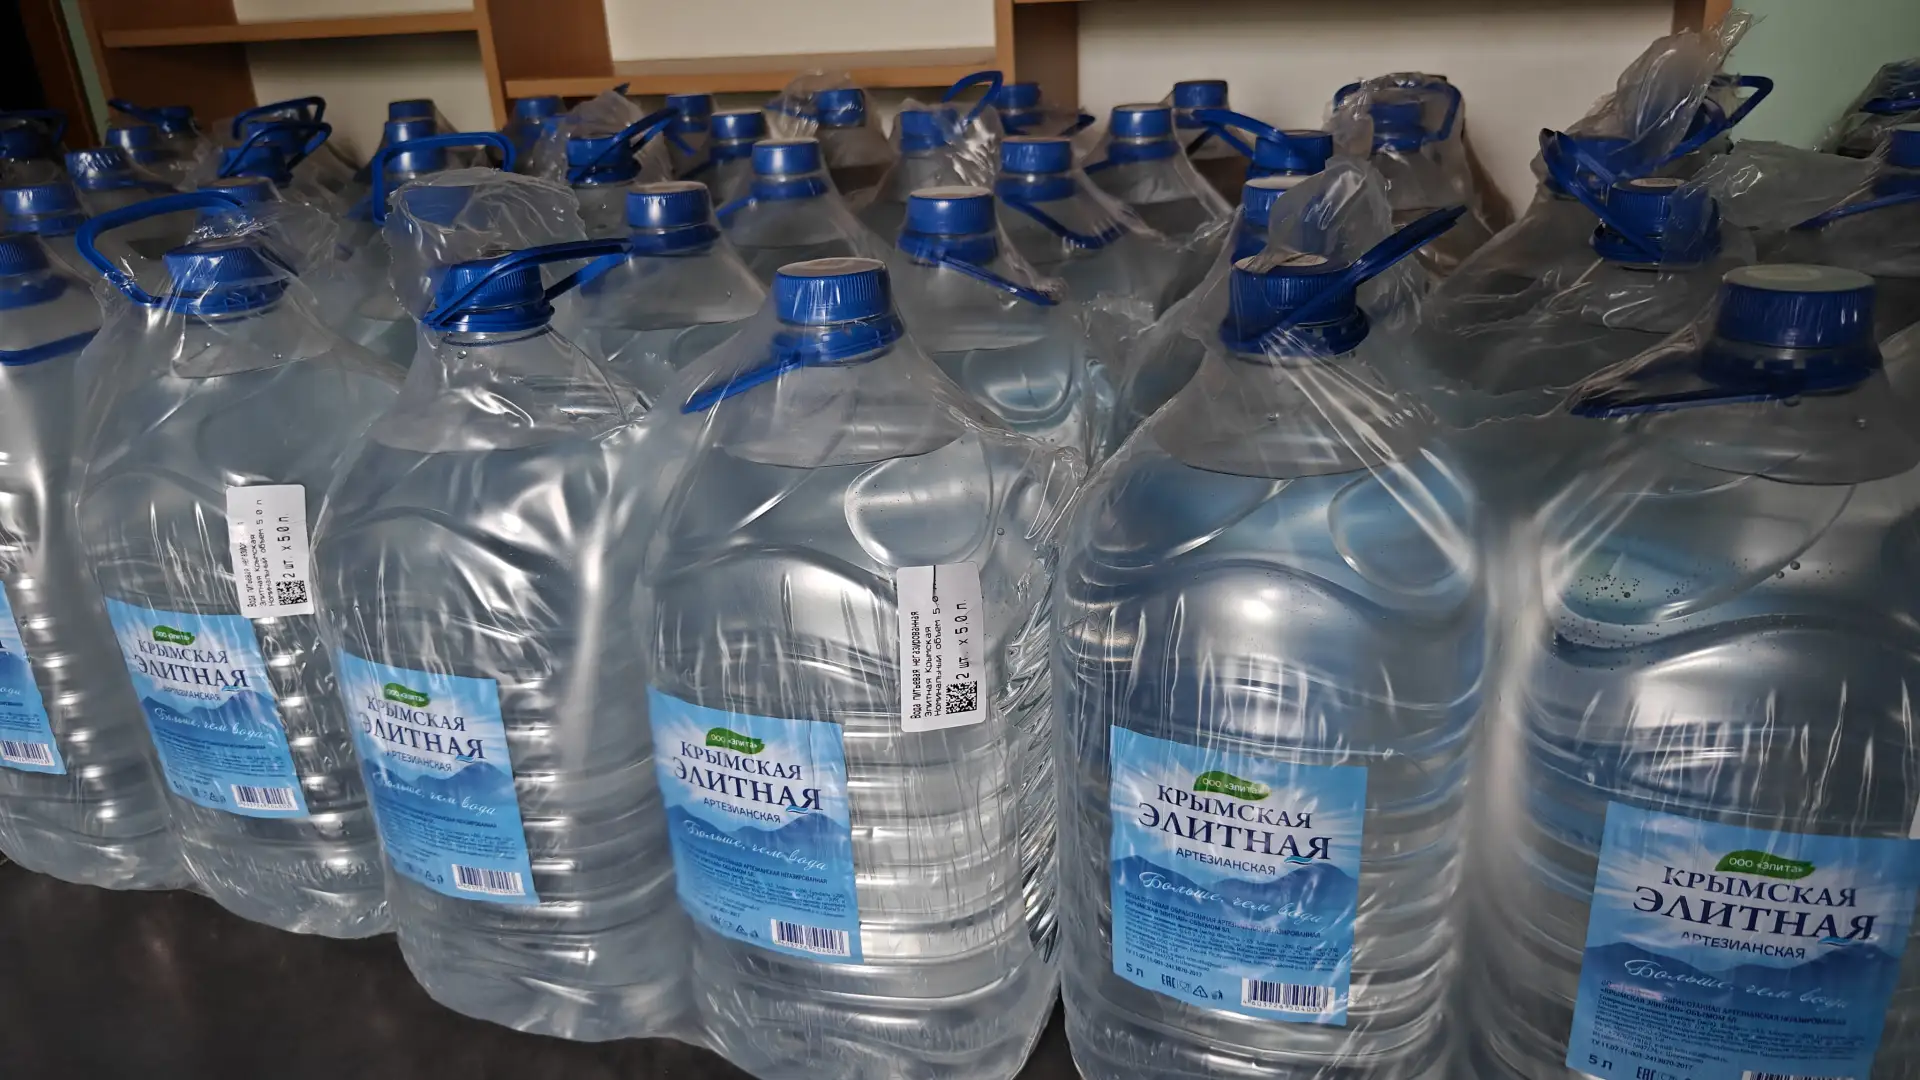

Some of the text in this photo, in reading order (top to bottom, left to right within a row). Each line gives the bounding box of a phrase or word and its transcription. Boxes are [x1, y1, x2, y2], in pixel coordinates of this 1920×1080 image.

[933, 619, 942, 650] объем
[137, 639, 228, 664] КРЫМСКАЯ
[910, 610, 922, 720] Вода питьевая негазированная
[958, 651, 970, 669] шт.
[134, 654, 250, 688] ЭЛИТНАЯ
[924, 626, 933, 717] Элитная Крымская
[934, 654, 943, 717] Номинальный
[955, 671, 970, 680] 2
[366, 695, 466, 732] КРЫМСКАЯ
[359, 712, 487, 760] ЭЛИТНАЯ
[680, 740, 803, 781] КРЫМСКАЯ
[672, 756, 824, 812] ЭЛИТНАЯ
[1202, 778, 1262, 794] ООО «Элита
[461, 796, 496, 816] вода
[703, 797, 781, 824] АРТЕЗИАНСКАЯ
[1157, 783, 1314, 829] КРЫМСКАЯ
[1138, 802, 1333, 861] ЭЛИТНАЯ
[751, 843, 784, 859] чем
[786, 848, 829, 872] вода
[1176, 847, 1276, 876] АРТЕЗИАНСКАЯ
[1728, 856, 1803, 874] ООО «Элита»
[1662, 865, 1857, 908] КРЫМСКАЯ
[1233, 896, 1272, 912] чем
[1278, 901, 1323, 926] вода
[1632, 885, 1878, 941] ЭЛИТНАЯ
[1680, 930, 1806, 960] АРТЕЗИАНСКАЯ
[1126, 962, 1133, 973] 5
[1588, 1053, 1598, 1065] 5
